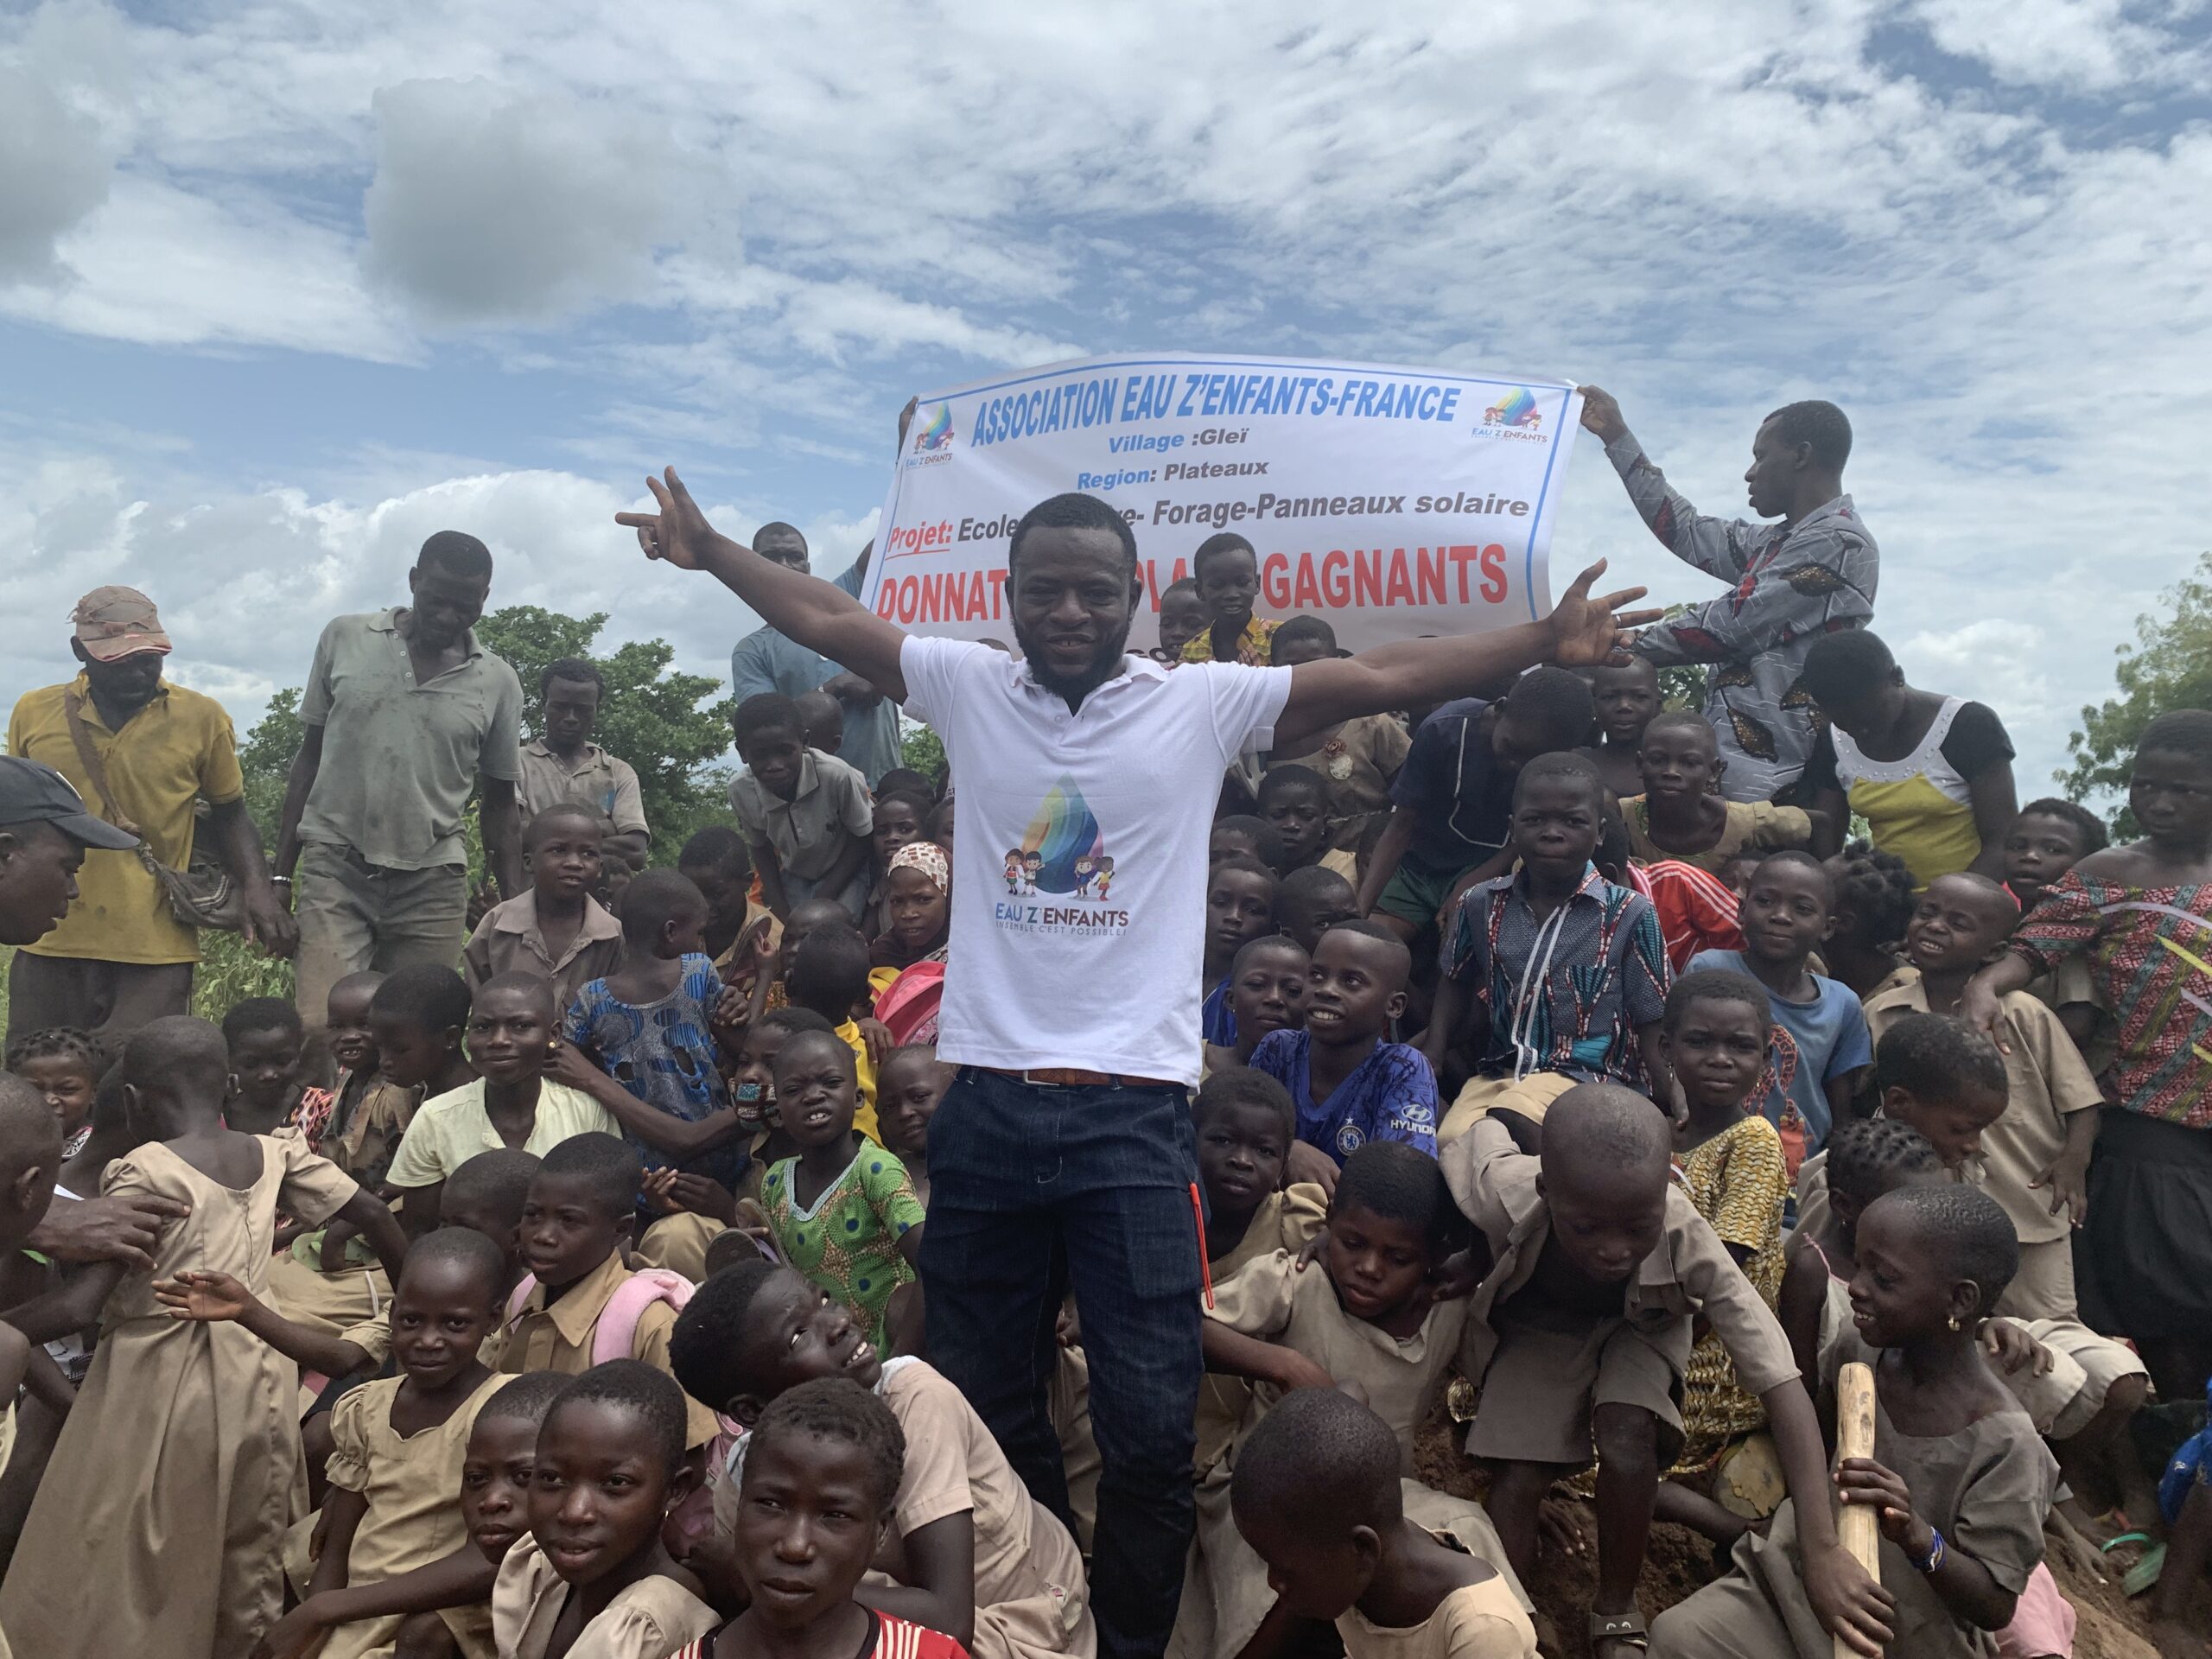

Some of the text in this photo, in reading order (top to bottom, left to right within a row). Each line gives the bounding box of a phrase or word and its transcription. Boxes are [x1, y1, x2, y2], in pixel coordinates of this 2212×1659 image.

[971, 373, 1461, 448] ASSOCIATION EAU Z'ENFANTS-FRANCE
[1109, 434, 1185, 454] Village
[1471, 427, 1492, 435] EAU
[1503, 430, 1548, 443] ENFANTS
[906, 458, 919, 467] EAU
[925, 453, 953, 465] ENFANTS
[1077, 461, 1270, 491] Region: Plateaux
[1153, 492, 1408, 530] Forage-Panneaux
[1414, 491, 1530, 518] solaire
[887, 514, 1020, 554] Projet: Ecole
[876, 569, 1008, 625] DONNAT
[1262, 543, 1509, 610] GAGNANTS
[995, 902, 1023, 922] EAU
[1039, 925, 1065, 934] C'EST
[1390, 1119, 1437, 1138] HYUNDA
